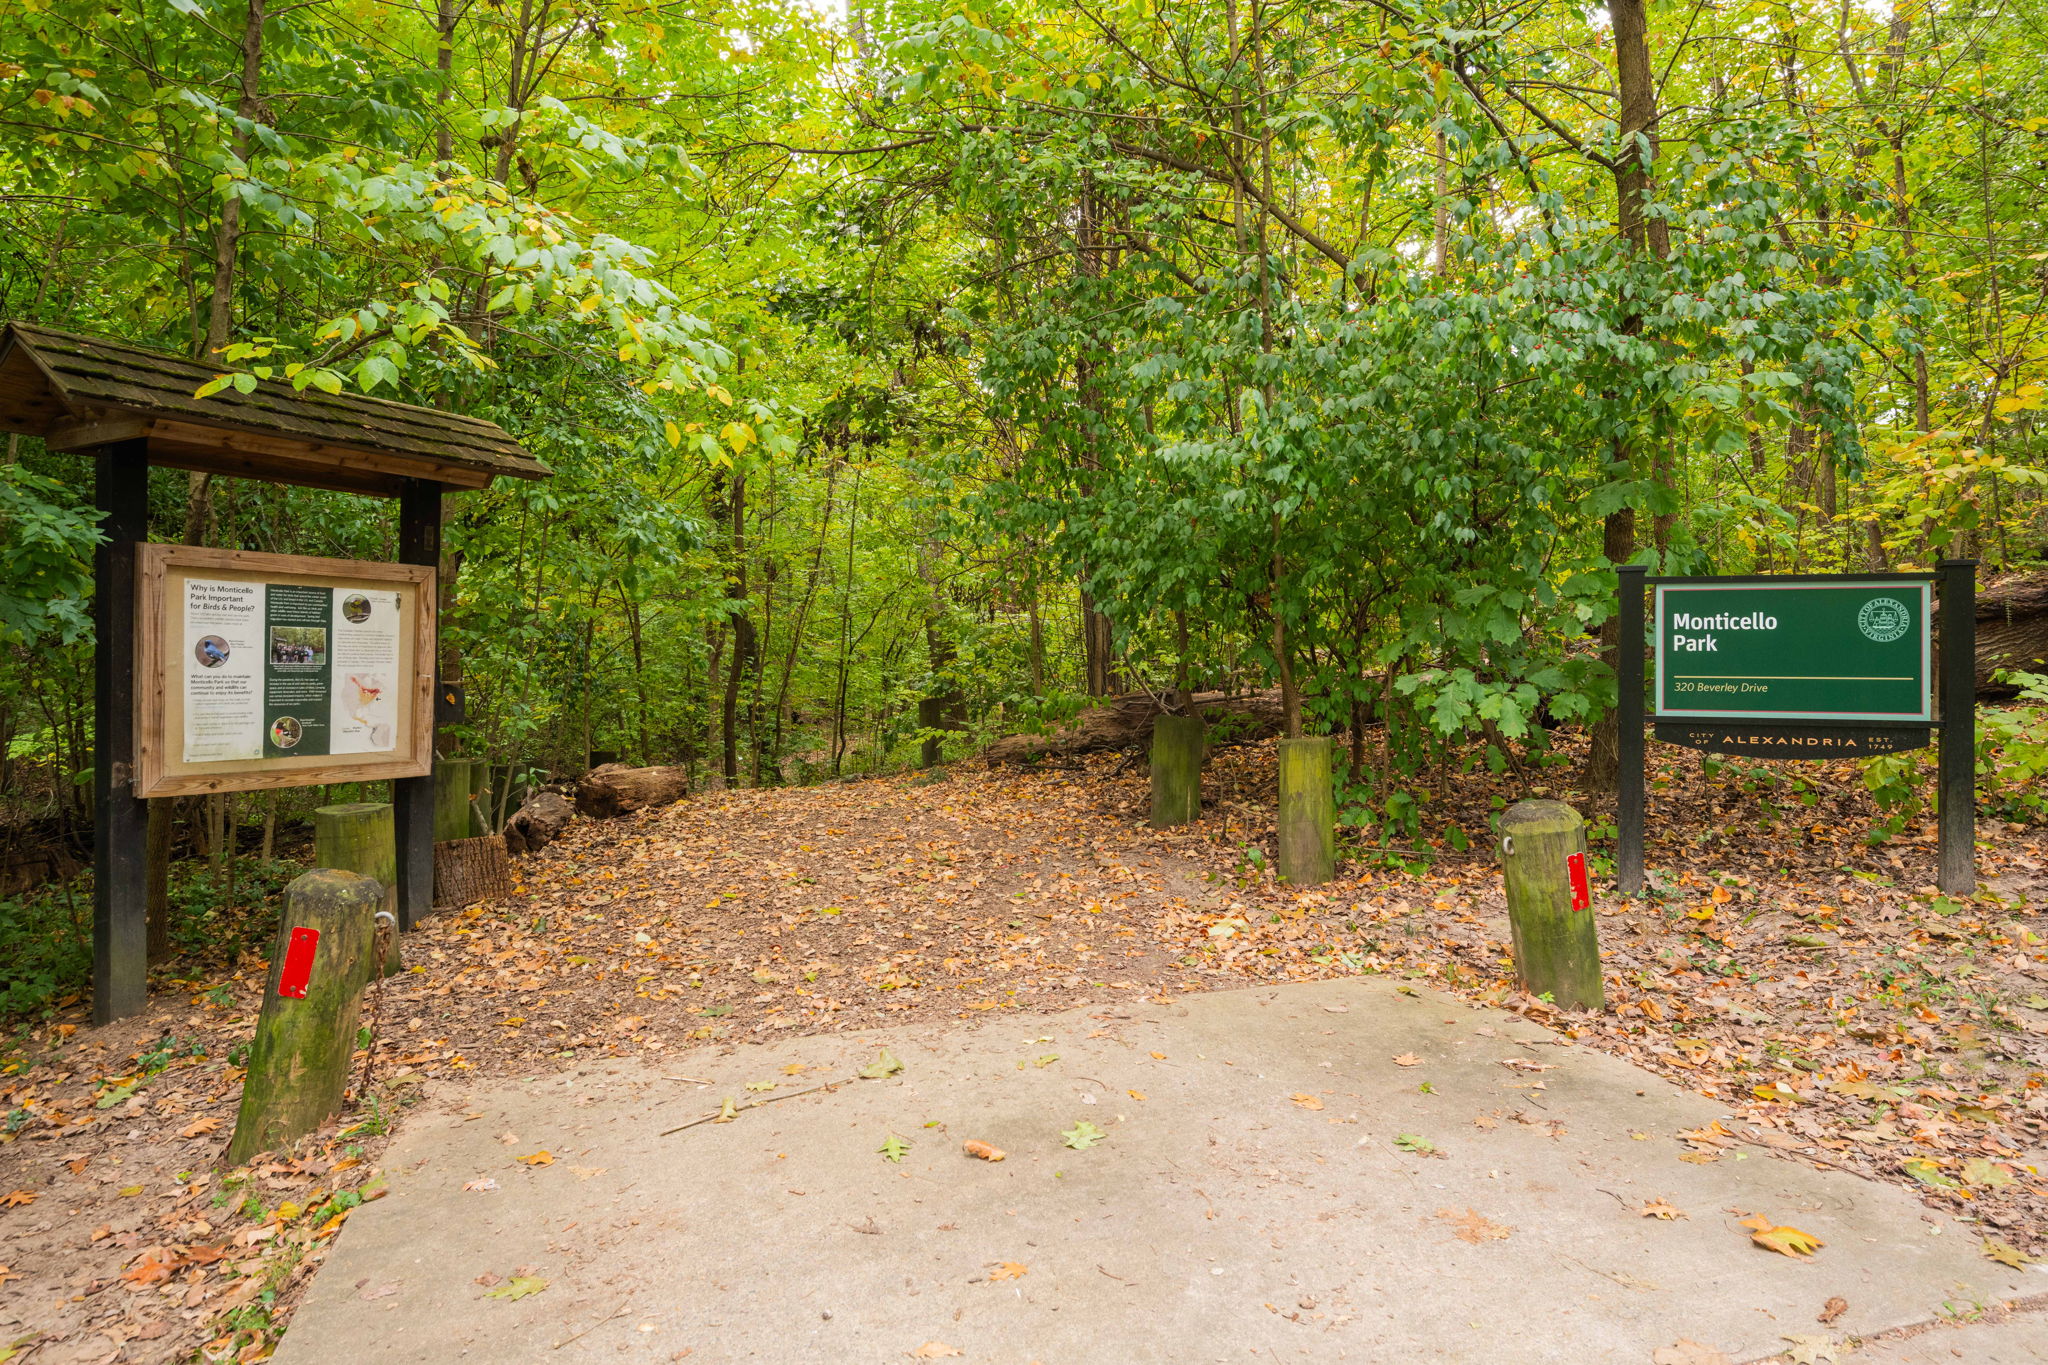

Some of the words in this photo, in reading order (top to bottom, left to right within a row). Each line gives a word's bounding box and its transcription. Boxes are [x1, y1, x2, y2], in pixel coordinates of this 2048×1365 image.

[190, 584, 208, 592] Why
[217, 586, 254, 594] Monticello
[1673, 612, 1778, 630] Monticello
[1673, 634, 1718, 652] Park
[1674, 682, 1695, 692] 320
[1696, 682, 1739, 694] Beverley
[1741, 683, 1768, 693] Drive
[1722, 736, 1857, 747] ALEXANDRIA
